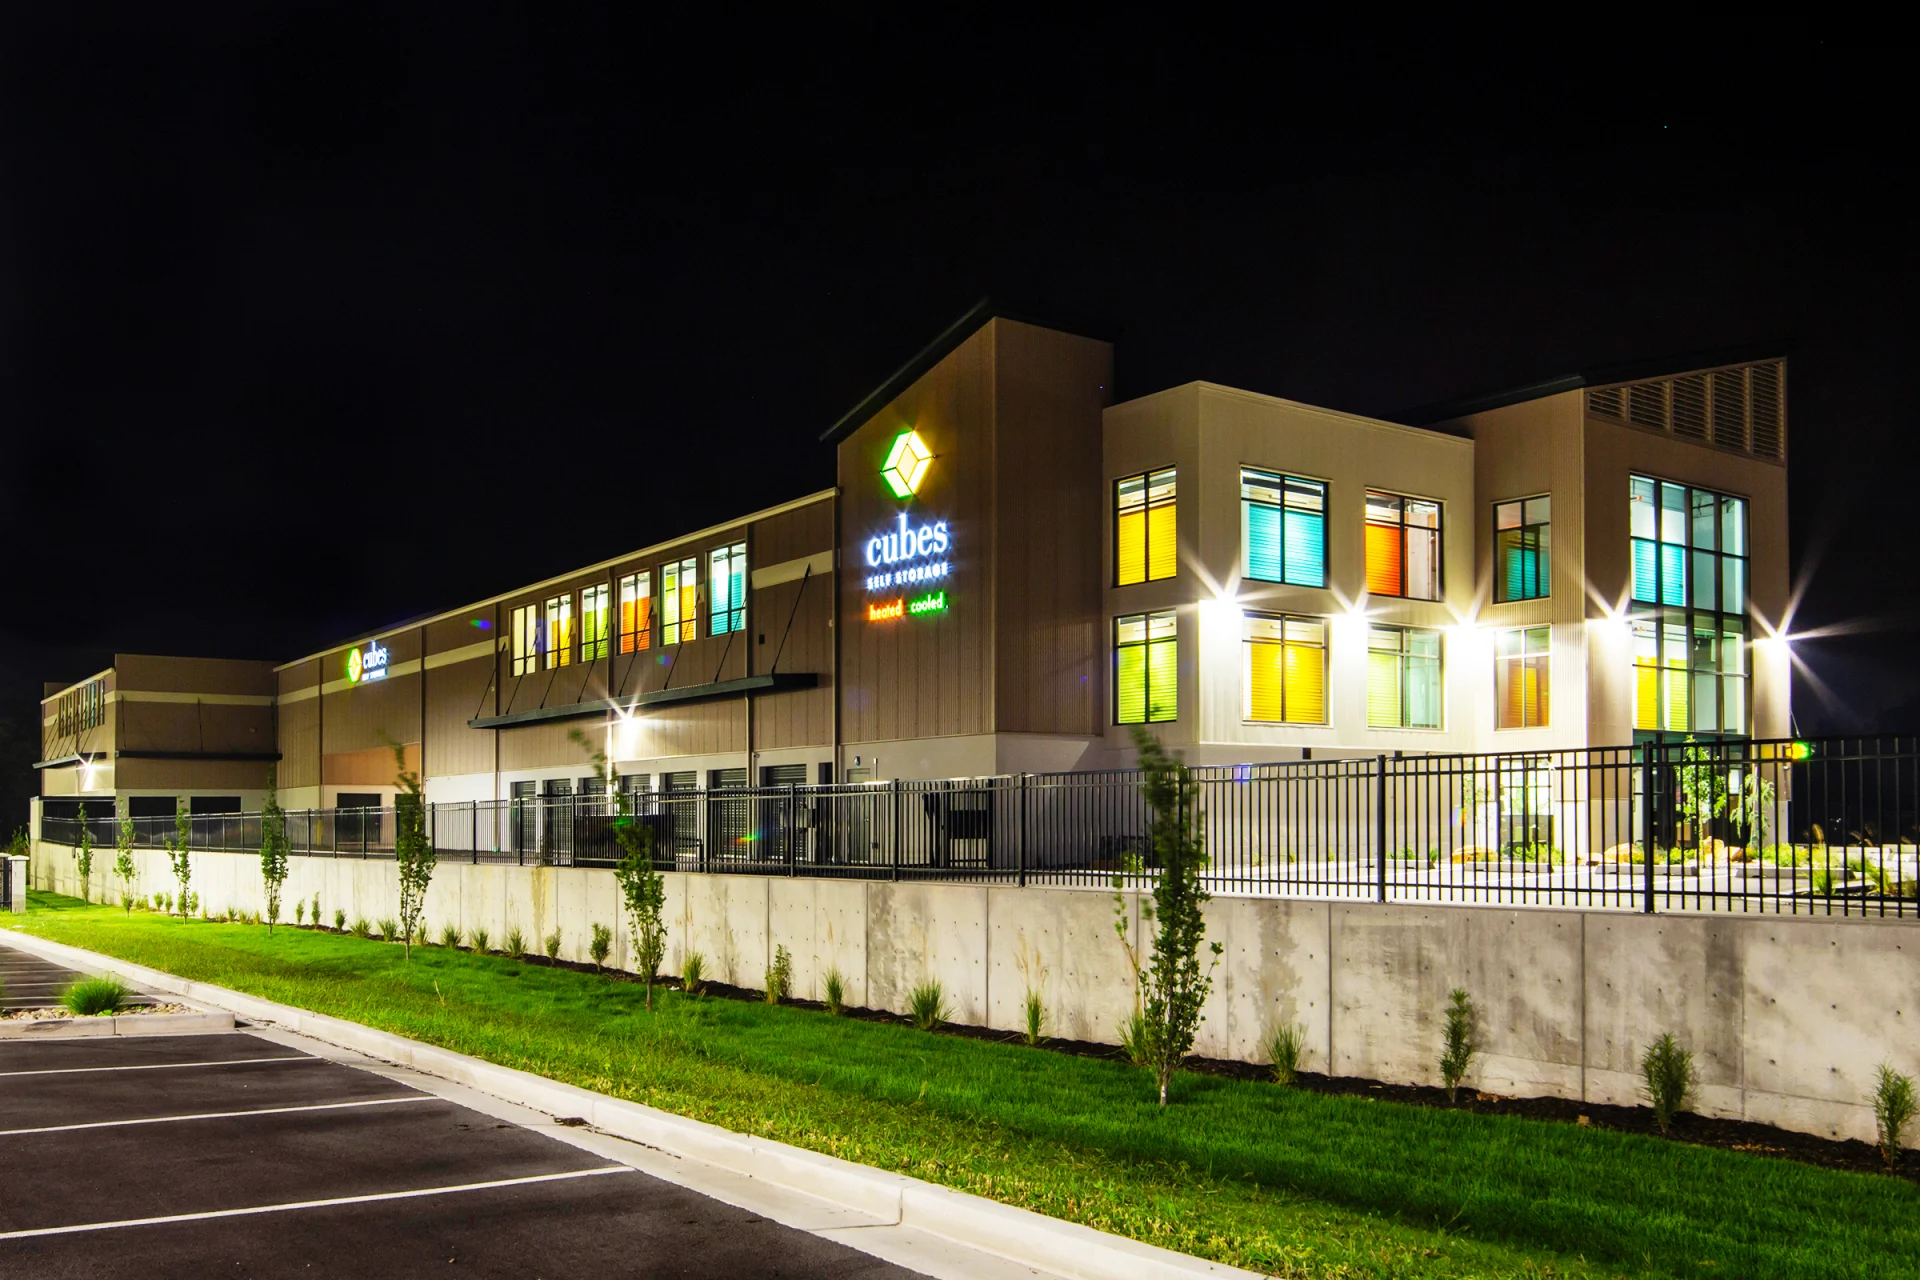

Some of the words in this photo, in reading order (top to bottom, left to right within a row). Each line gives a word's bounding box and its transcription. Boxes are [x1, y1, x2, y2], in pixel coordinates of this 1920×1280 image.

[867, 513, 948, 567] cubes
[867, 574, 892, 591] SELF
[895, 562, 949, 585] STORAGE
[869, 599, 902, 621] heated
[910, 592, 943, 613] cooled
[363, 641, 387, 669] cubes
